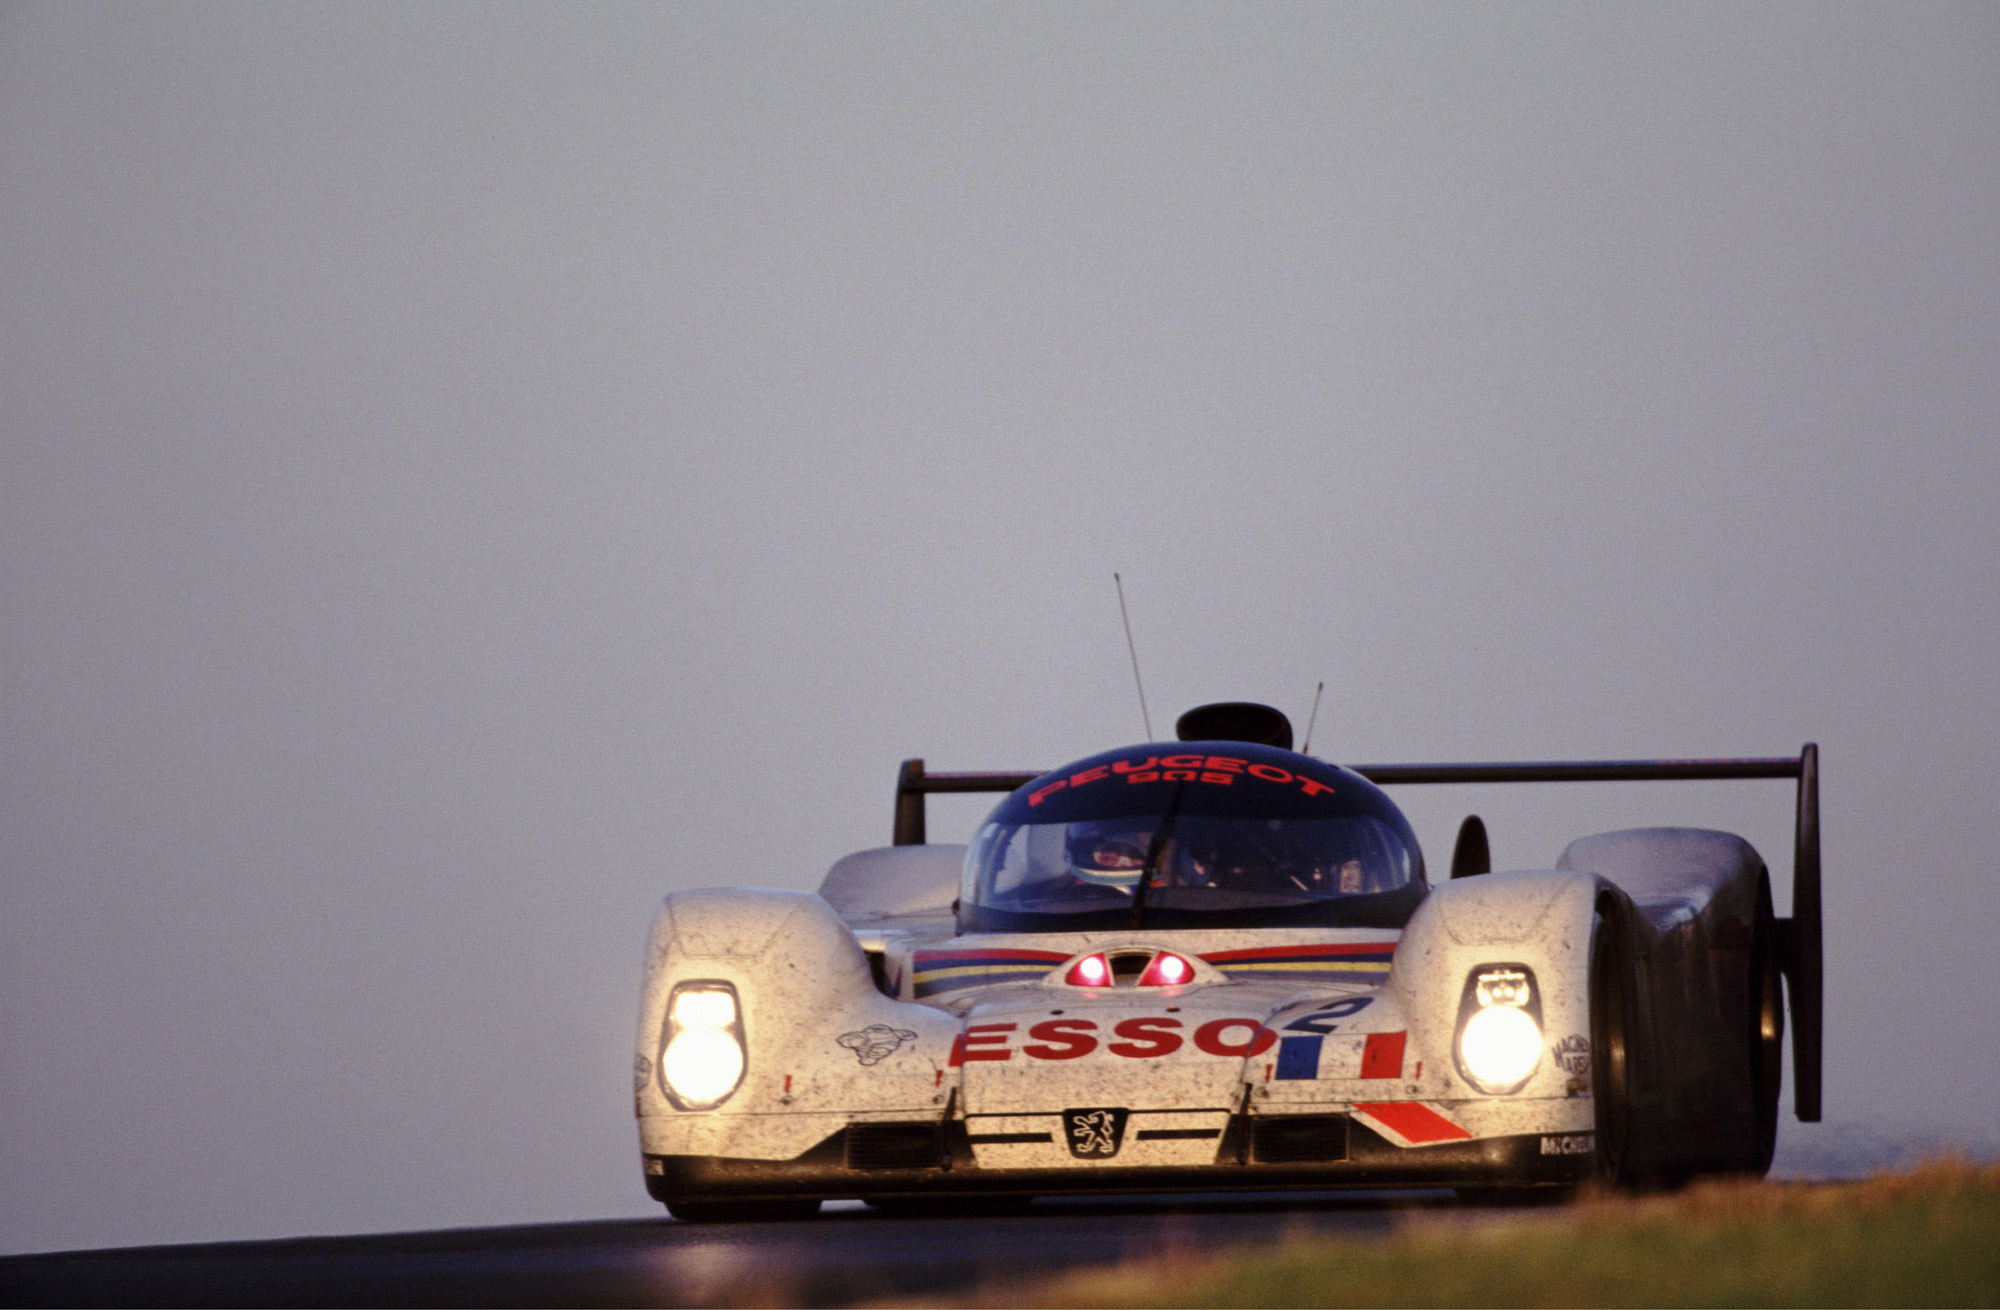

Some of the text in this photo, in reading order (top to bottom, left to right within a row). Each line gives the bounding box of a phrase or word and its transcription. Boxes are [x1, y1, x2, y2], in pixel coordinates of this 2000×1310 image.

[1028, 755, 1335, 807] PEUGEOT
[1127, 771, 1234, 785] 905
[1283, 997, 1375, 1034] 2
[948, 1018, 1278, 1067] ESSO
